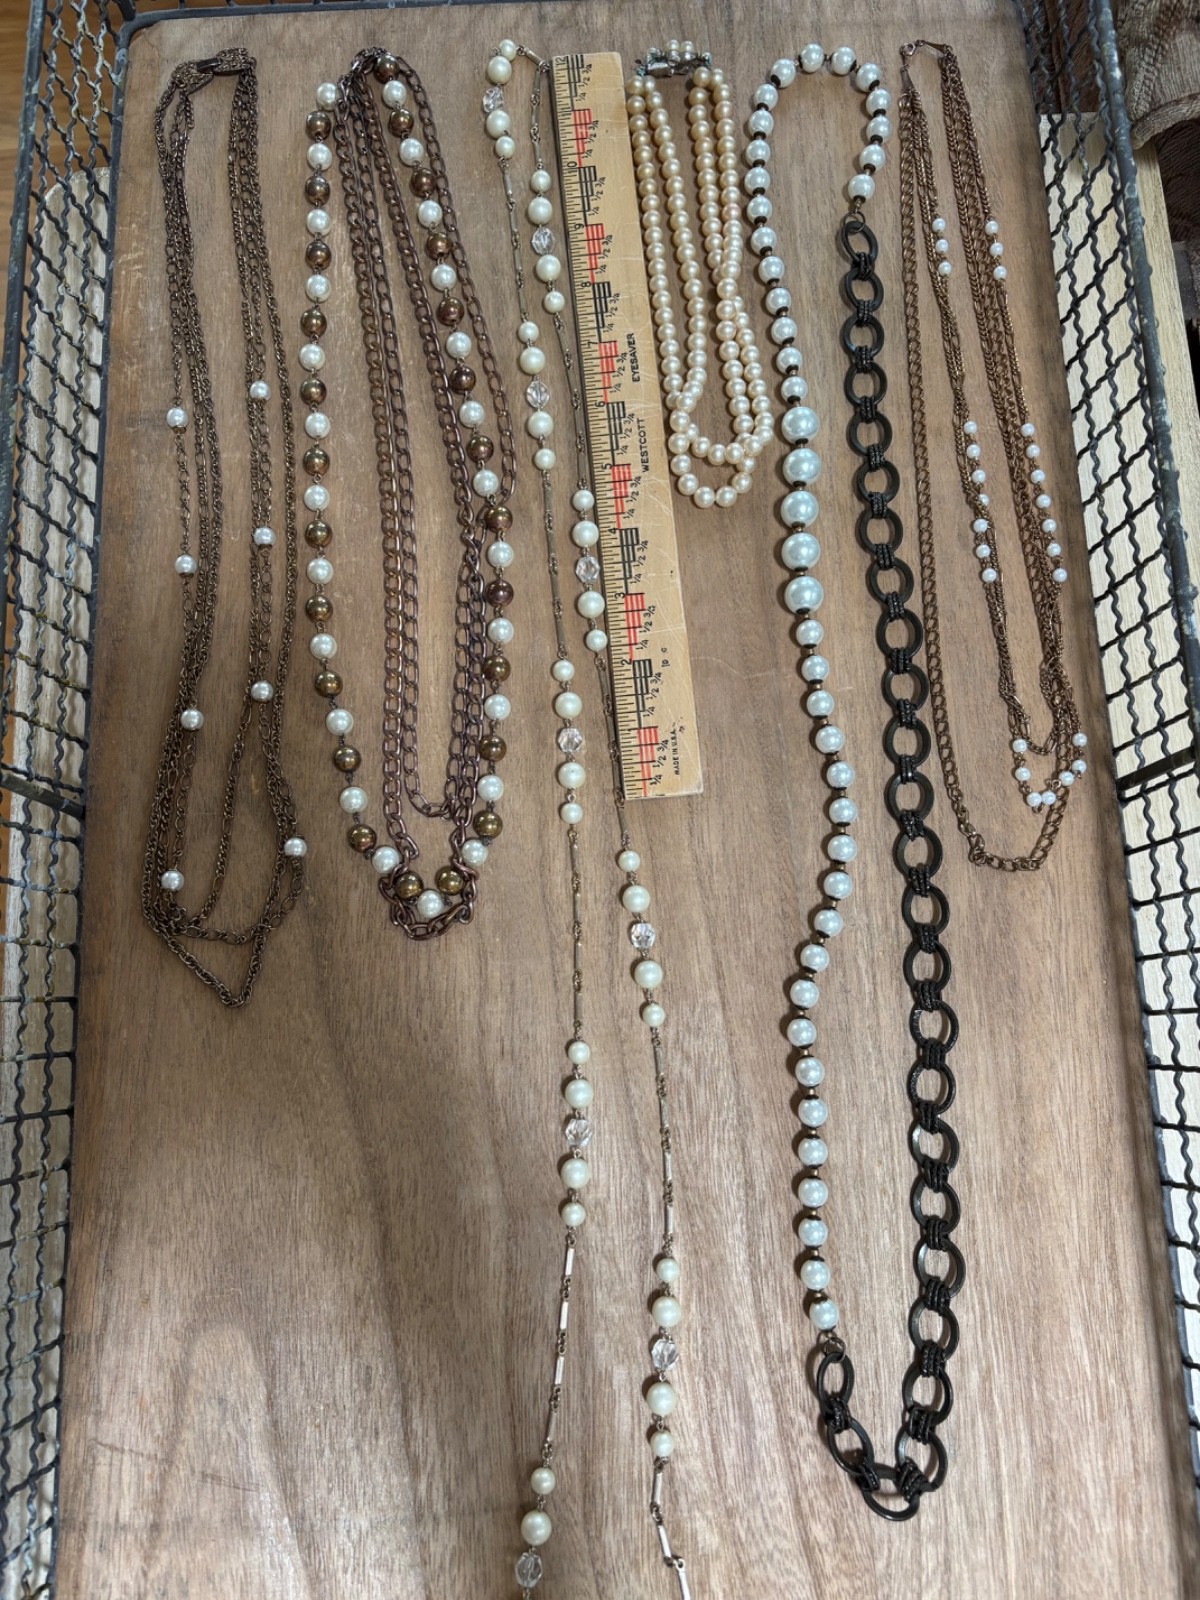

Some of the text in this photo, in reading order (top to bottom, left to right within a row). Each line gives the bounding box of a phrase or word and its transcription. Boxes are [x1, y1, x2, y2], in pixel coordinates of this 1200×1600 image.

[555, 56, 567, 66] 12
[567, 161, 578, 173] 10
[580, 280, 592, 288] 8
[587, 340, 598, 348] 7
[626, 332, 641, 382] EYESAVER
[595, 400, 606, 408] 6
[637, 417, 650, 473] WESTCOTT
[601, 462, 613, 470] 5
[620, 658, 633, 666] 2
[672, 756, 680, 775] MADE
